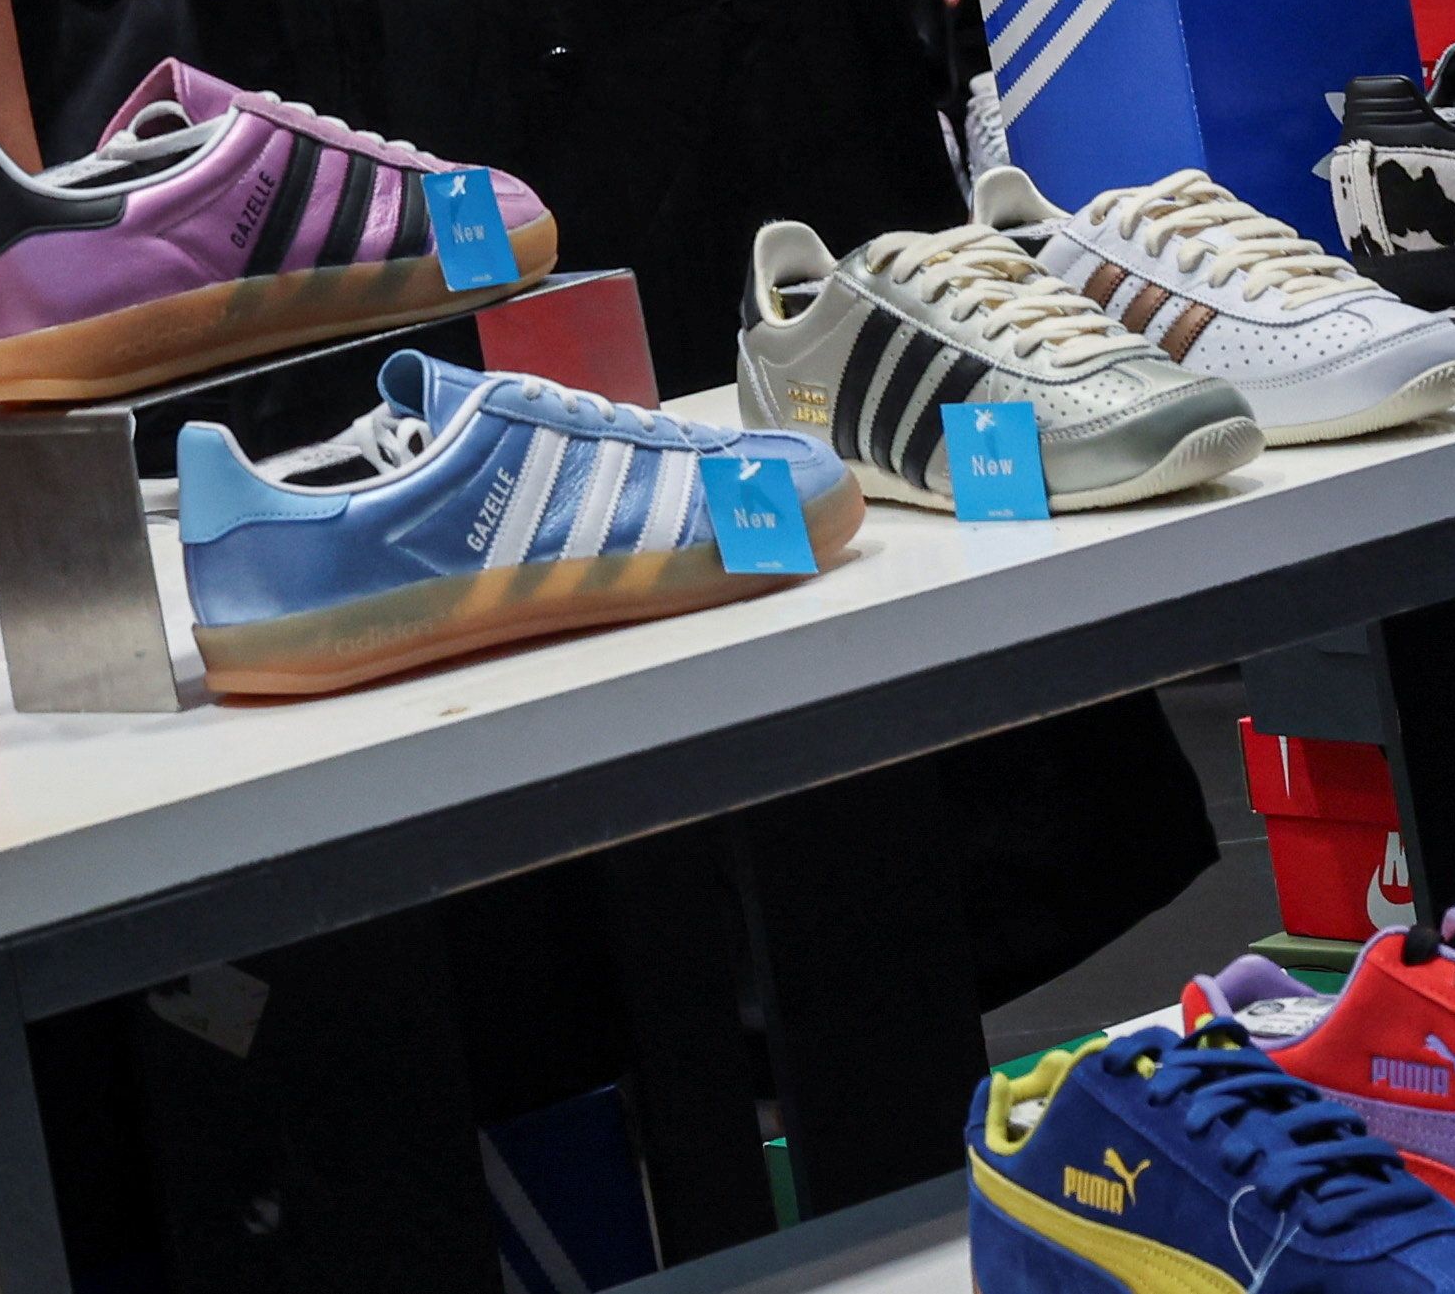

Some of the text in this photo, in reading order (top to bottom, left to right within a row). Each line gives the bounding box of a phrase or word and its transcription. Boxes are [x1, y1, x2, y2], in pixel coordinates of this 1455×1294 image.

[230, 171, 276, 250] GAZELLE
[452, 223, 485, 245] New
[972, 454, 1013, 476] New
[467, 466, 516, 552] GAZELLE
[733, 507, 776, 529] New
[1372, 1057, 1450, 1098] PUMA
[1063, 1165, 1125, 1216] PUMA
